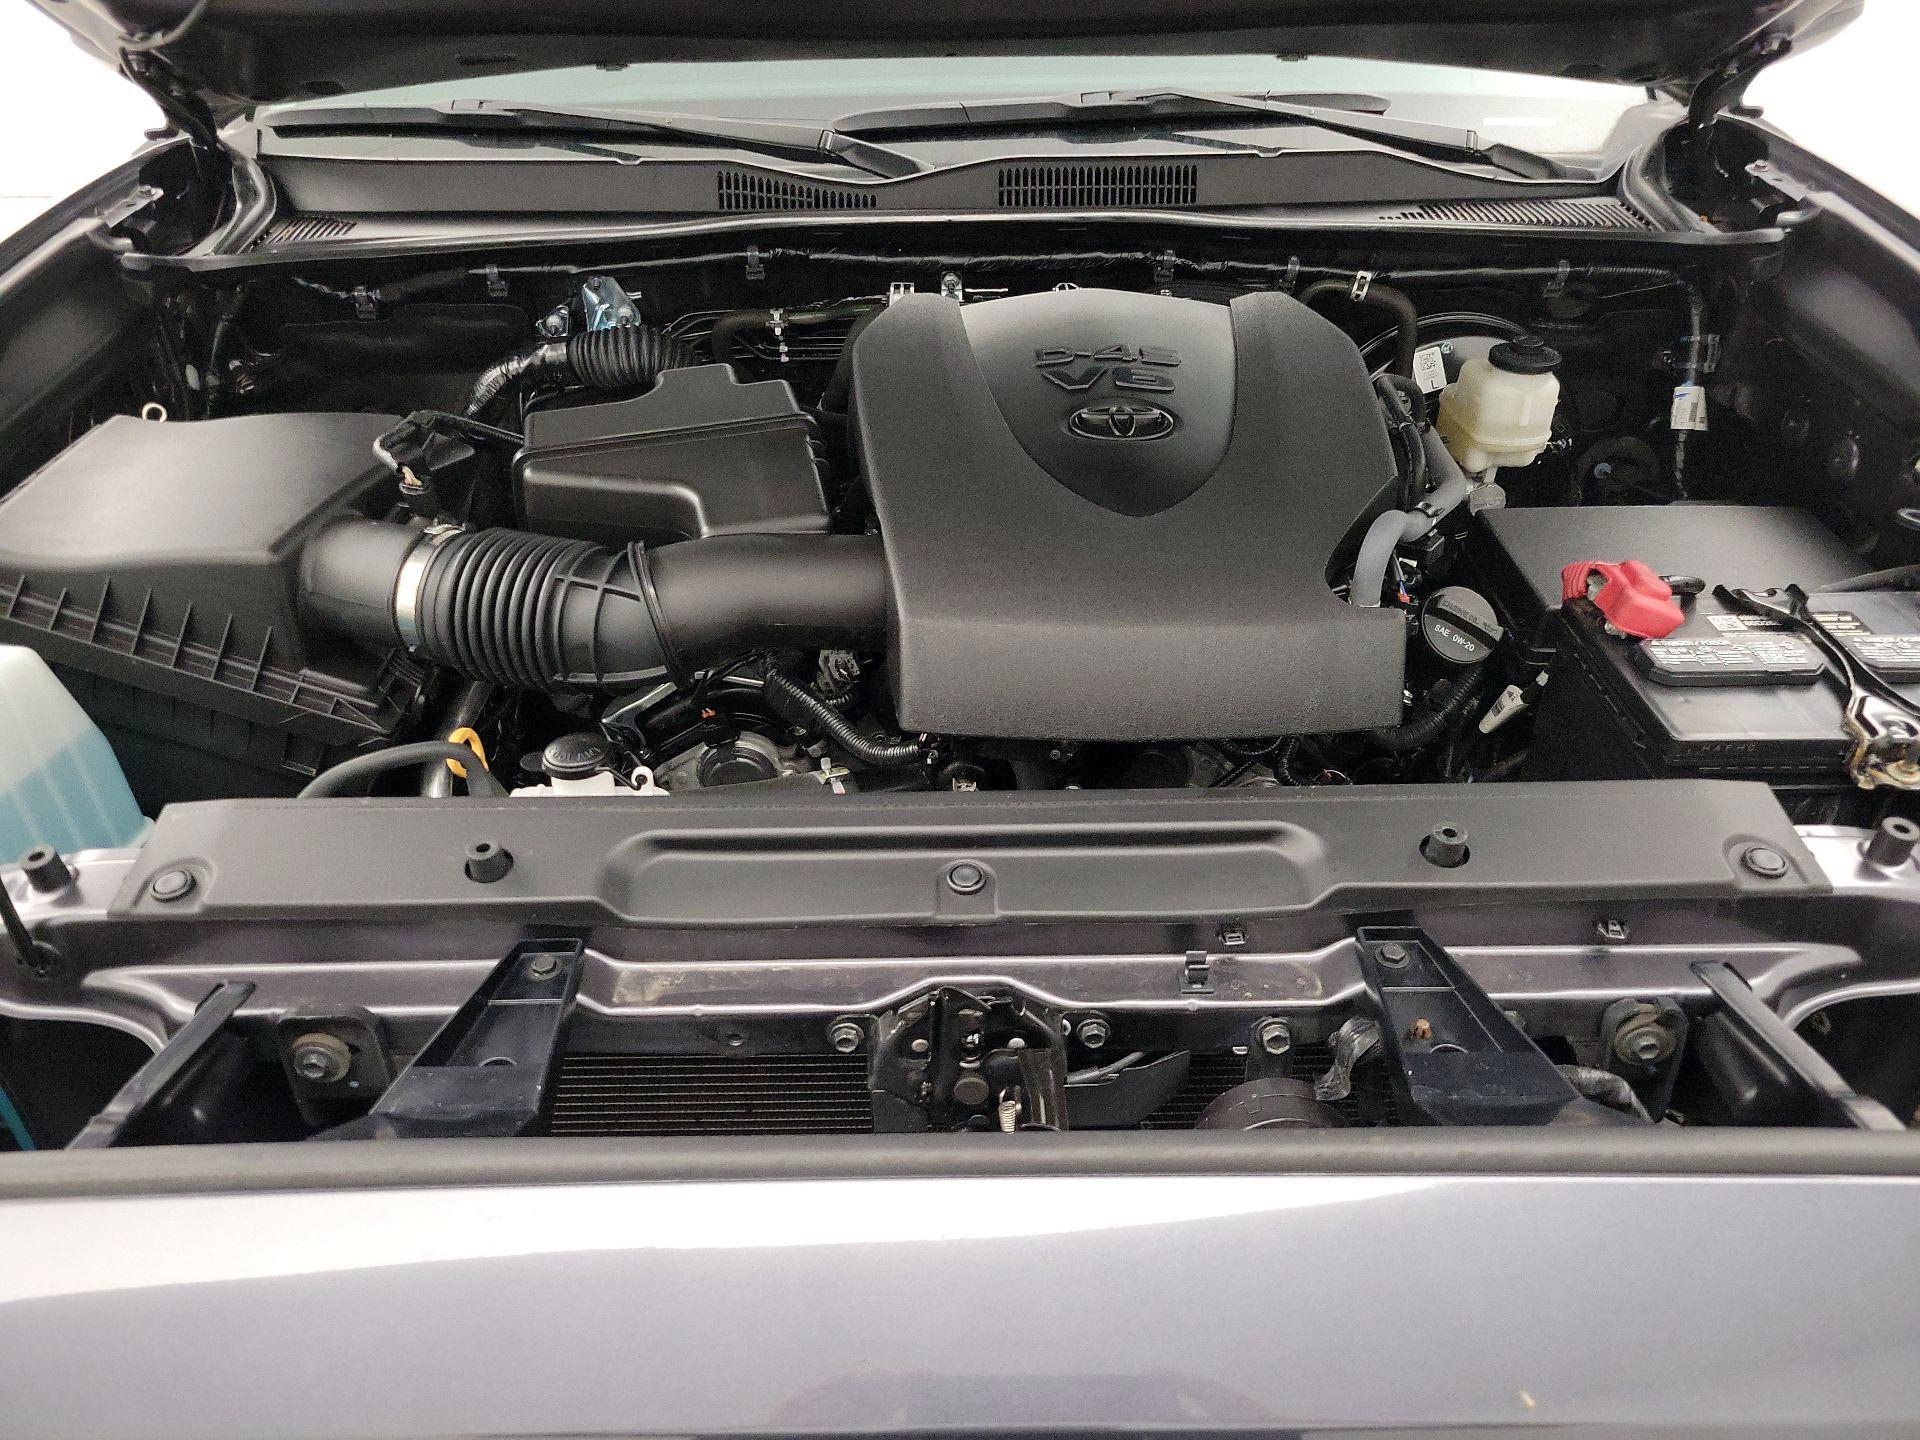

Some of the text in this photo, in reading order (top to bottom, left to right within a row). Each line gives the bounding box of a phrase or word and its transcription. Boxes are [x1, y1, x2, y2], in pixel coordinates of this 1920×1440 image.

[1041, 366, 1176, 391] V6
[1434, 624, 1475, 652] SAE 0W-20
